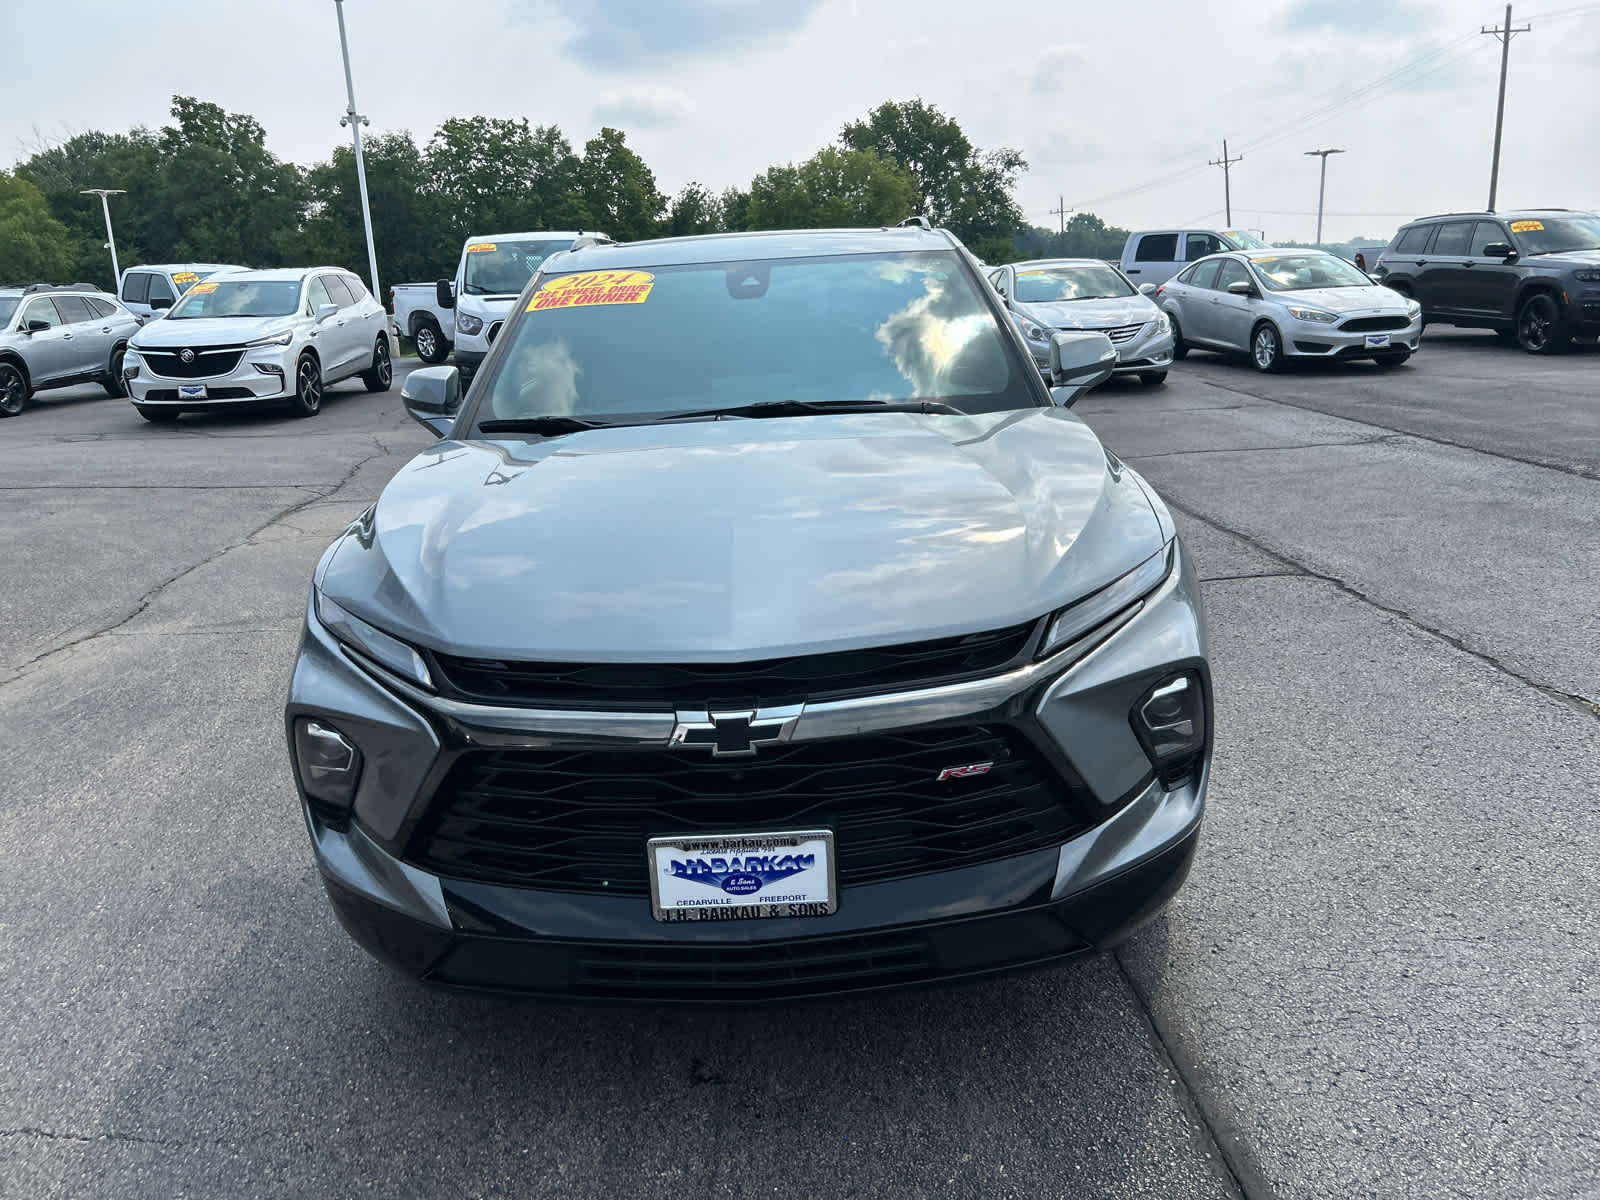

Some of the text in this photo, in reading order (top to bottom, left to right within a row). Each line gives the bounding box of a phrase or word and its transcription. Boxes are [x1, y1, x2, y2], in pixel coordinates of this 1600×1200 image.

[555, 272, 635, 290] 2024
[536, 284, 650, 299] ALL WHEEL DRIVE
[535, 292, 640, 309] ONE OWNER
[936, 761, 994, 781] RS
[690, 838, 792, 850] www.barkau.com
[676, 895, 807, 906] CEDARVILLE FREEPORT
[699, 904, 760, 920] BARKAU
[770, 904, 780, 917] &
[788, 902, 828, 915] SONS
